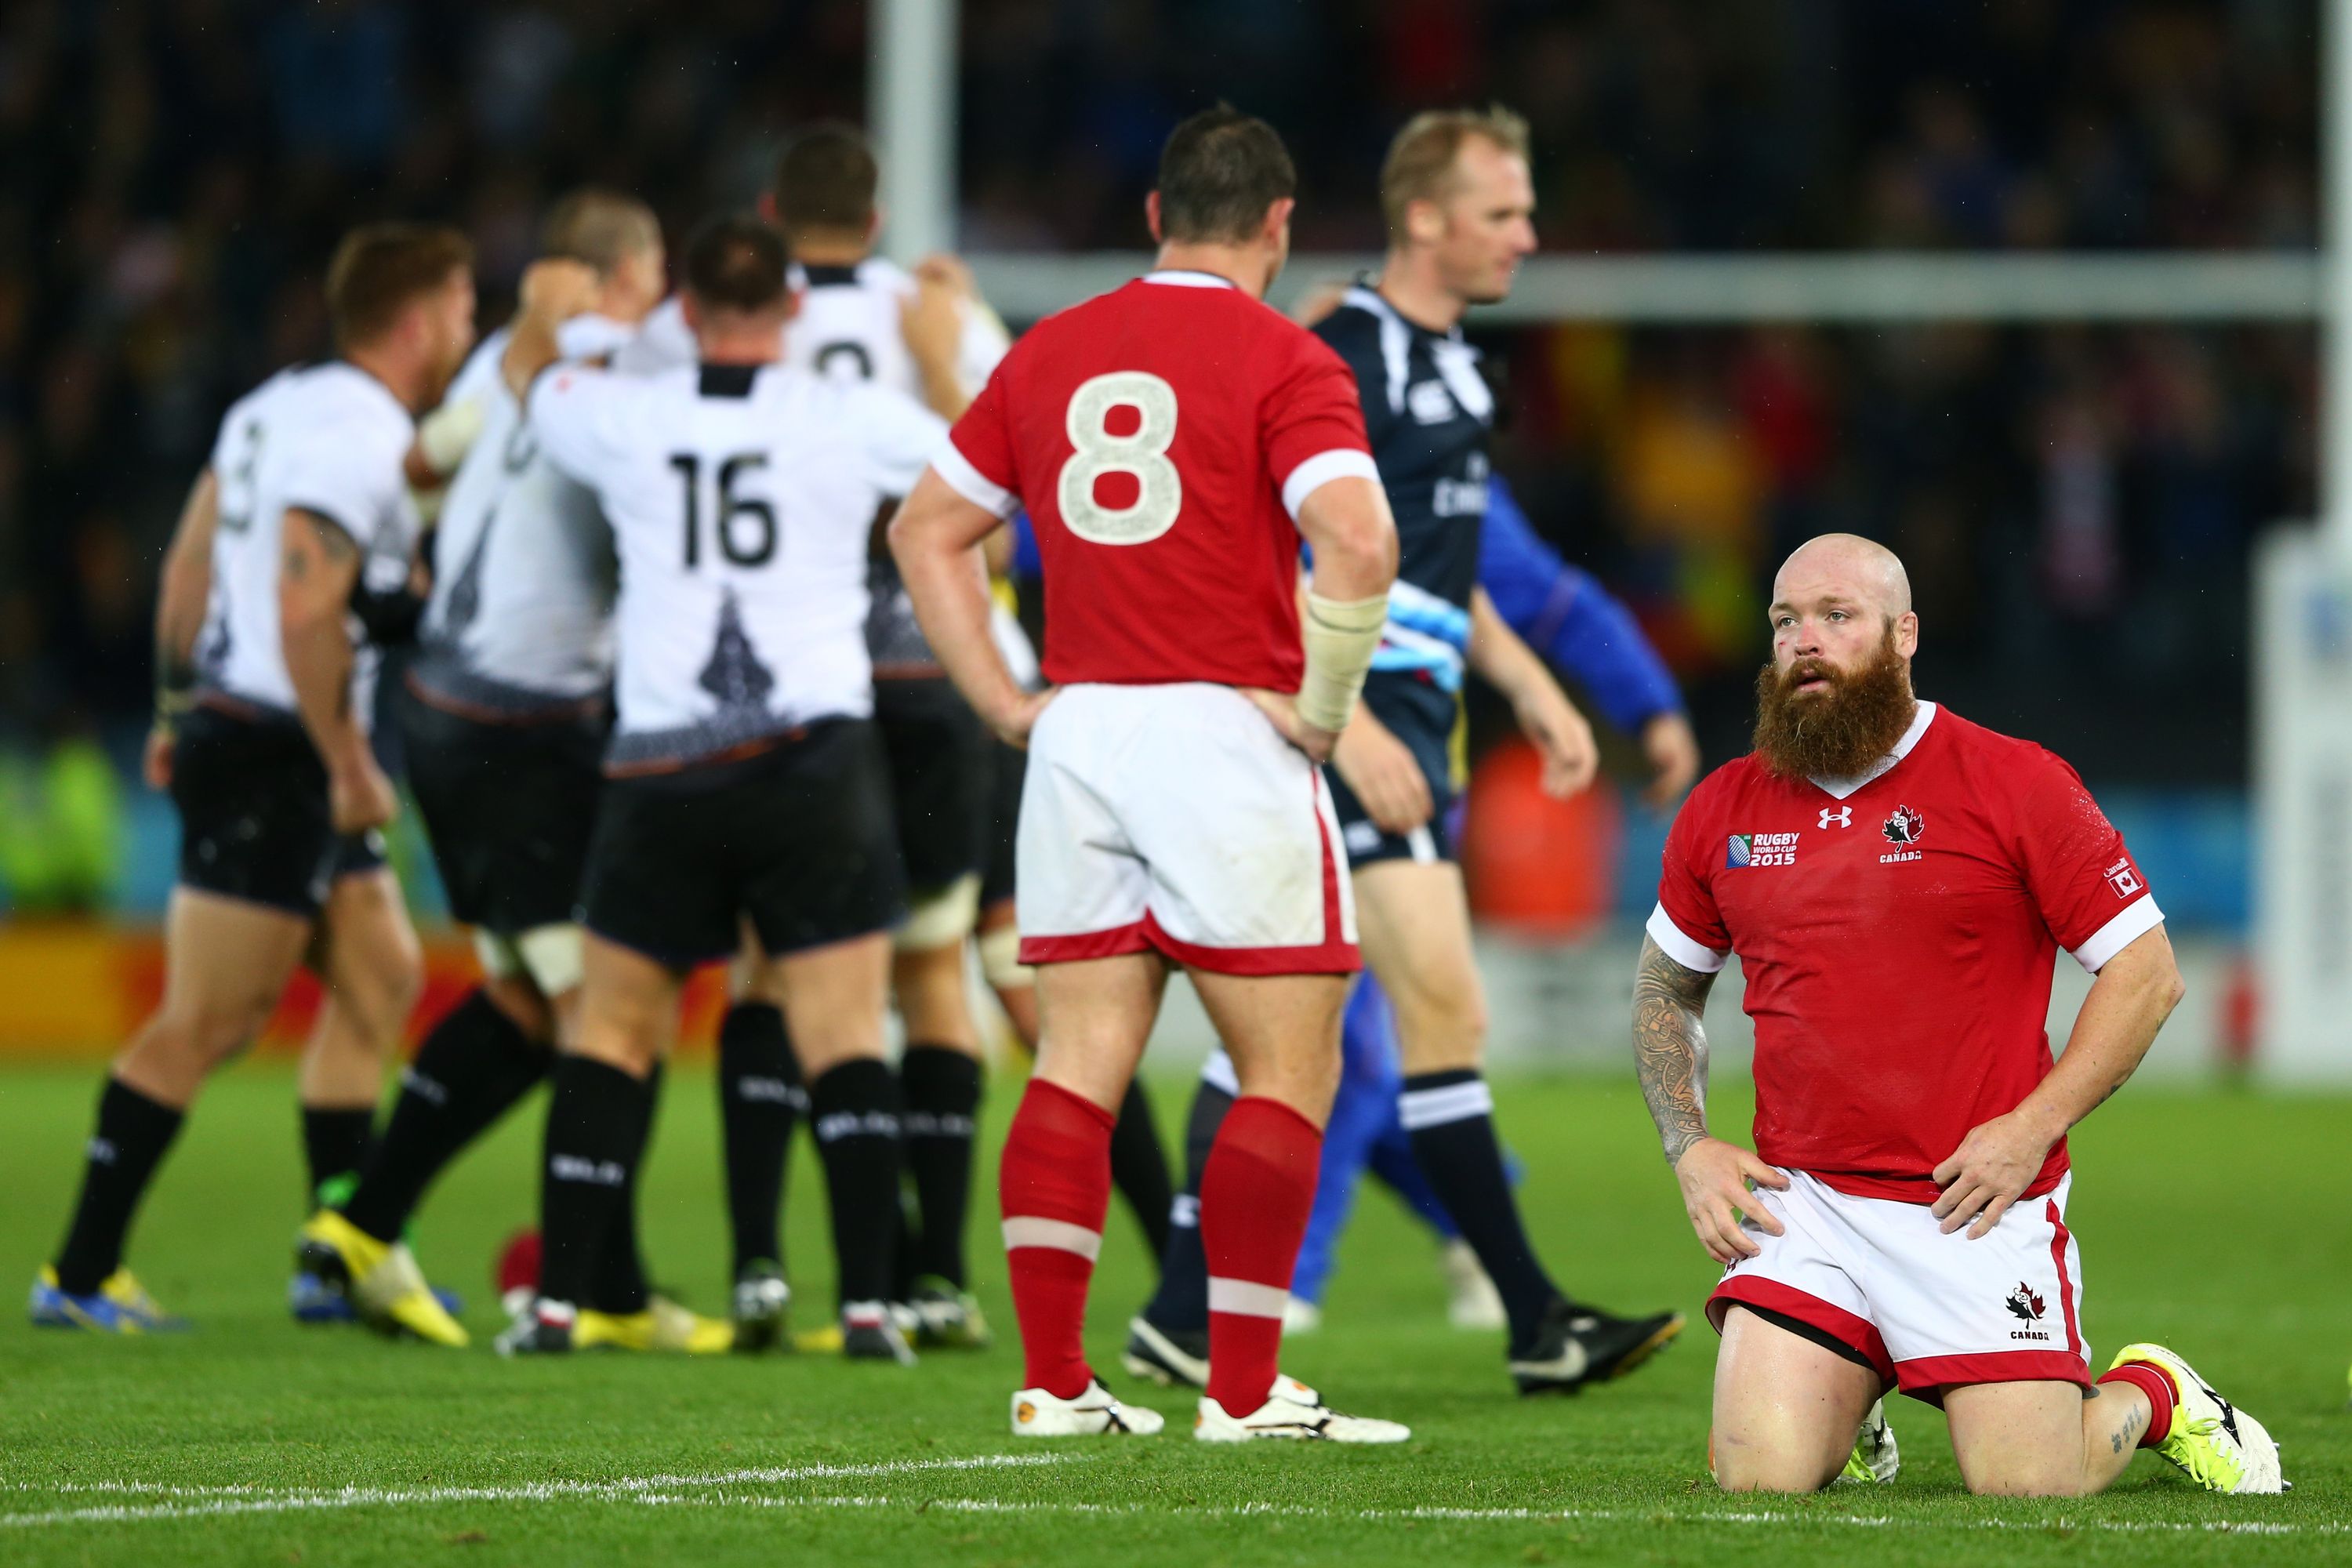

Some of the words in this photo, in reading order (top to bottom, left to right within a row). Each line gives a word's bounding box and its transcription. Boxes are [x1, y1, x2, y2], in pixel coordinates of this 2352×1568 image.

[1057, 370, 1182, 546] 8
[668, 451, 778, 571] 16
[1753, 832, 1800, 846] RUGBY
[1749, 853, 1795, 867] 2015
[1879, 850, 1922, 864] CANADA
[2010, 1330, 2050, 1341] CANADA
